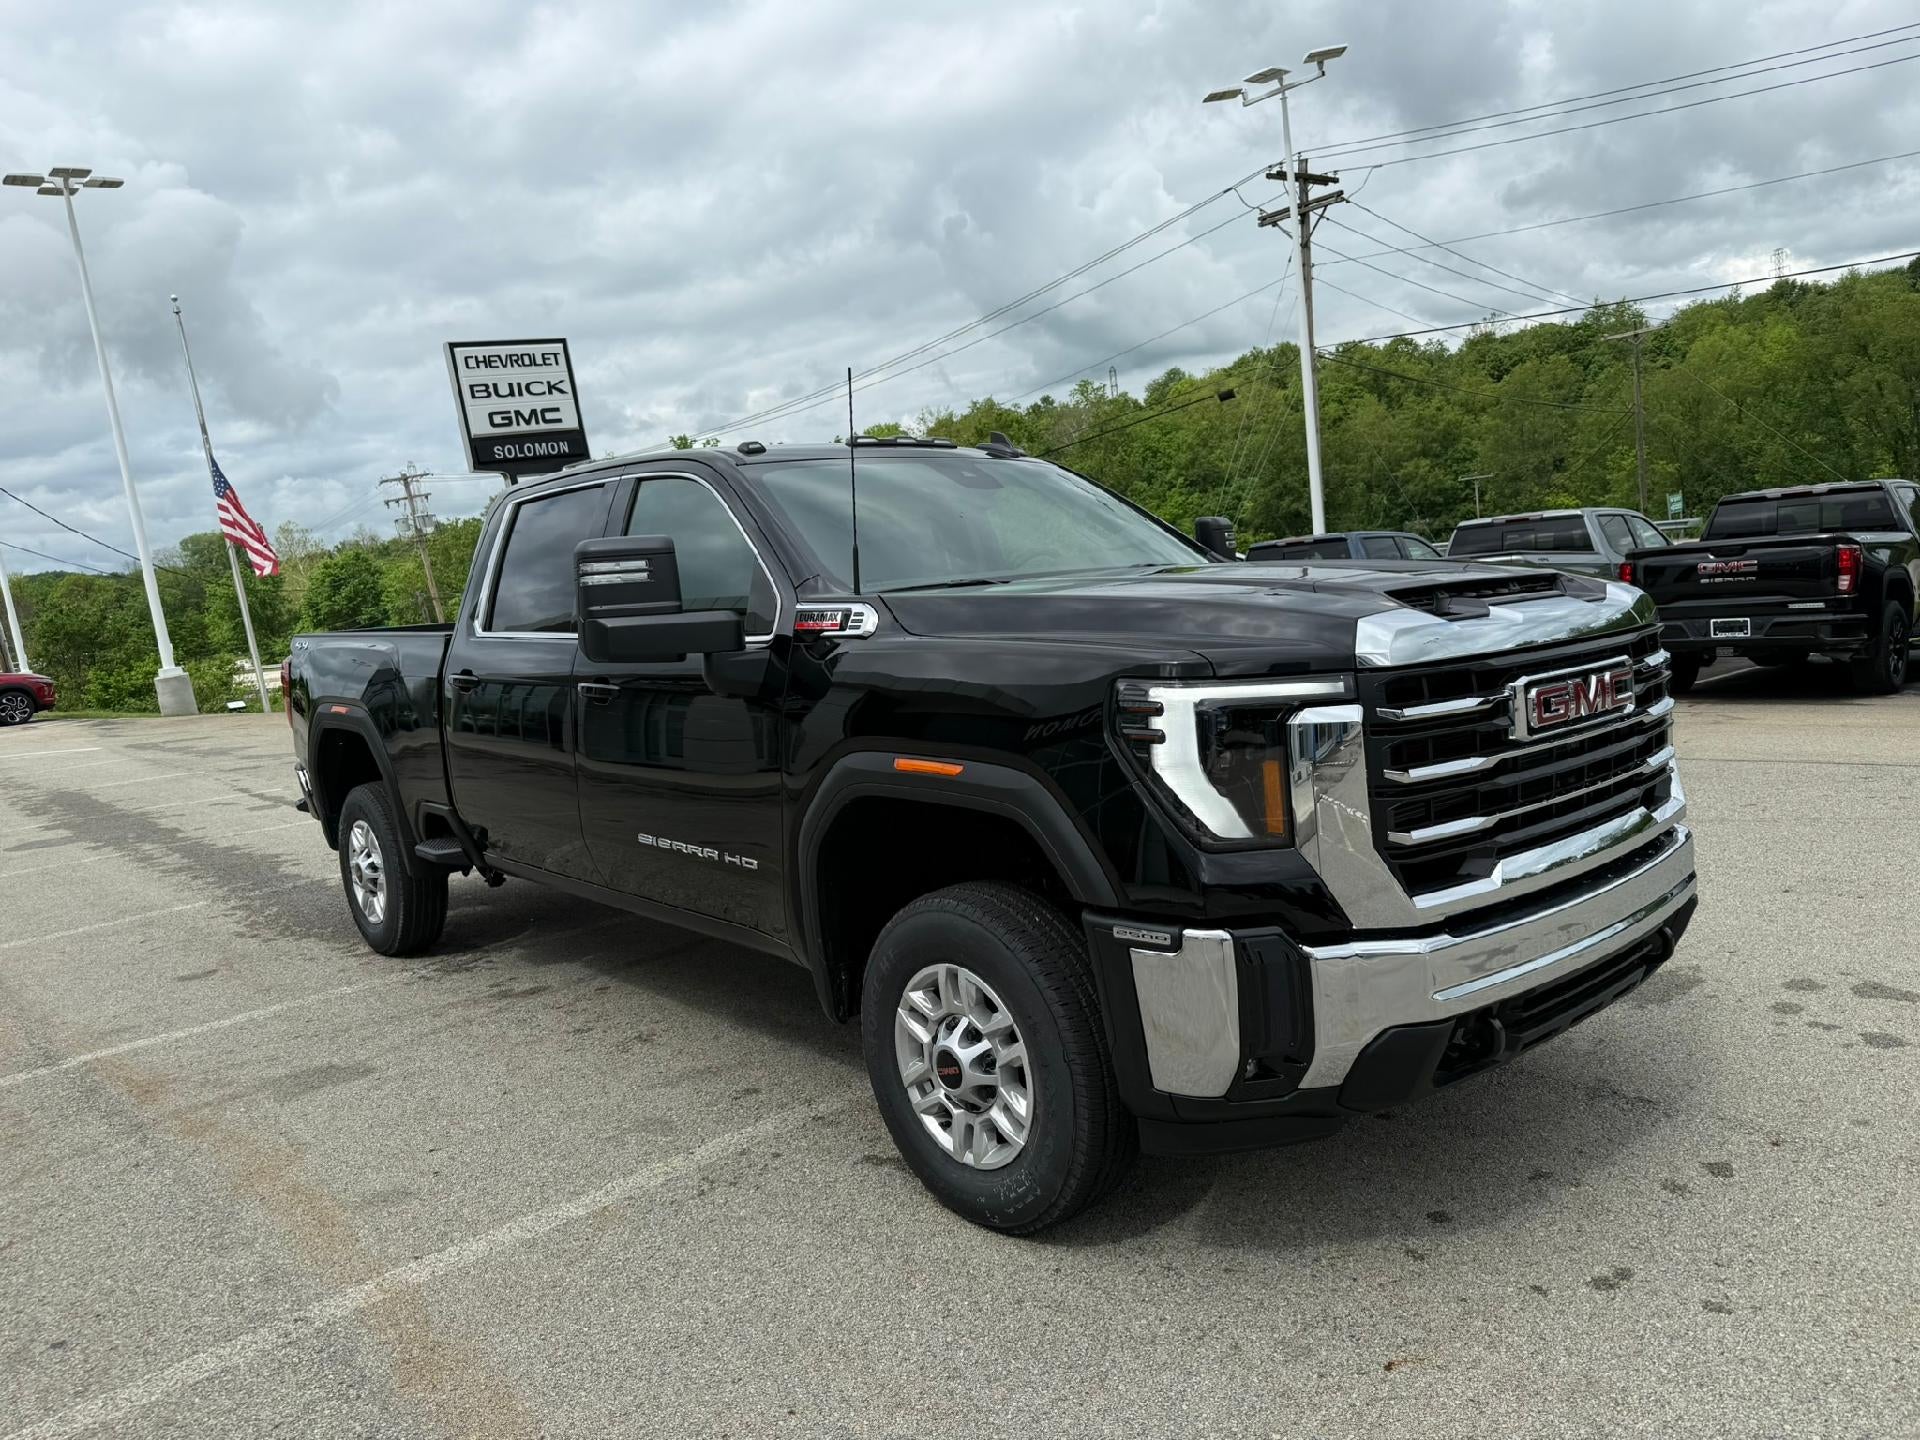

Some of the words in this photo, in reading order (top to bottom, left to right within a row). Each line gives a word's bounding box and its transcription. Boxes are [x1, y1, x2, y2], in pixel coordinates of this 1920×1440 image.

[464, 352, 560, 369] CHEVROLET
[468, 379, 569, 399] BUICK
[487, 407, 563, 428] GMC
[493, 441, 569, 459] SOLOMON
[1697, 560, 1758, 575] GMC
[1527, 668, 1634, 728] GMC
[637, 832, 719, 861] SIERRA
[723, 851, 758, 870] HD
[1113, 926, 1171, 945] 2500
